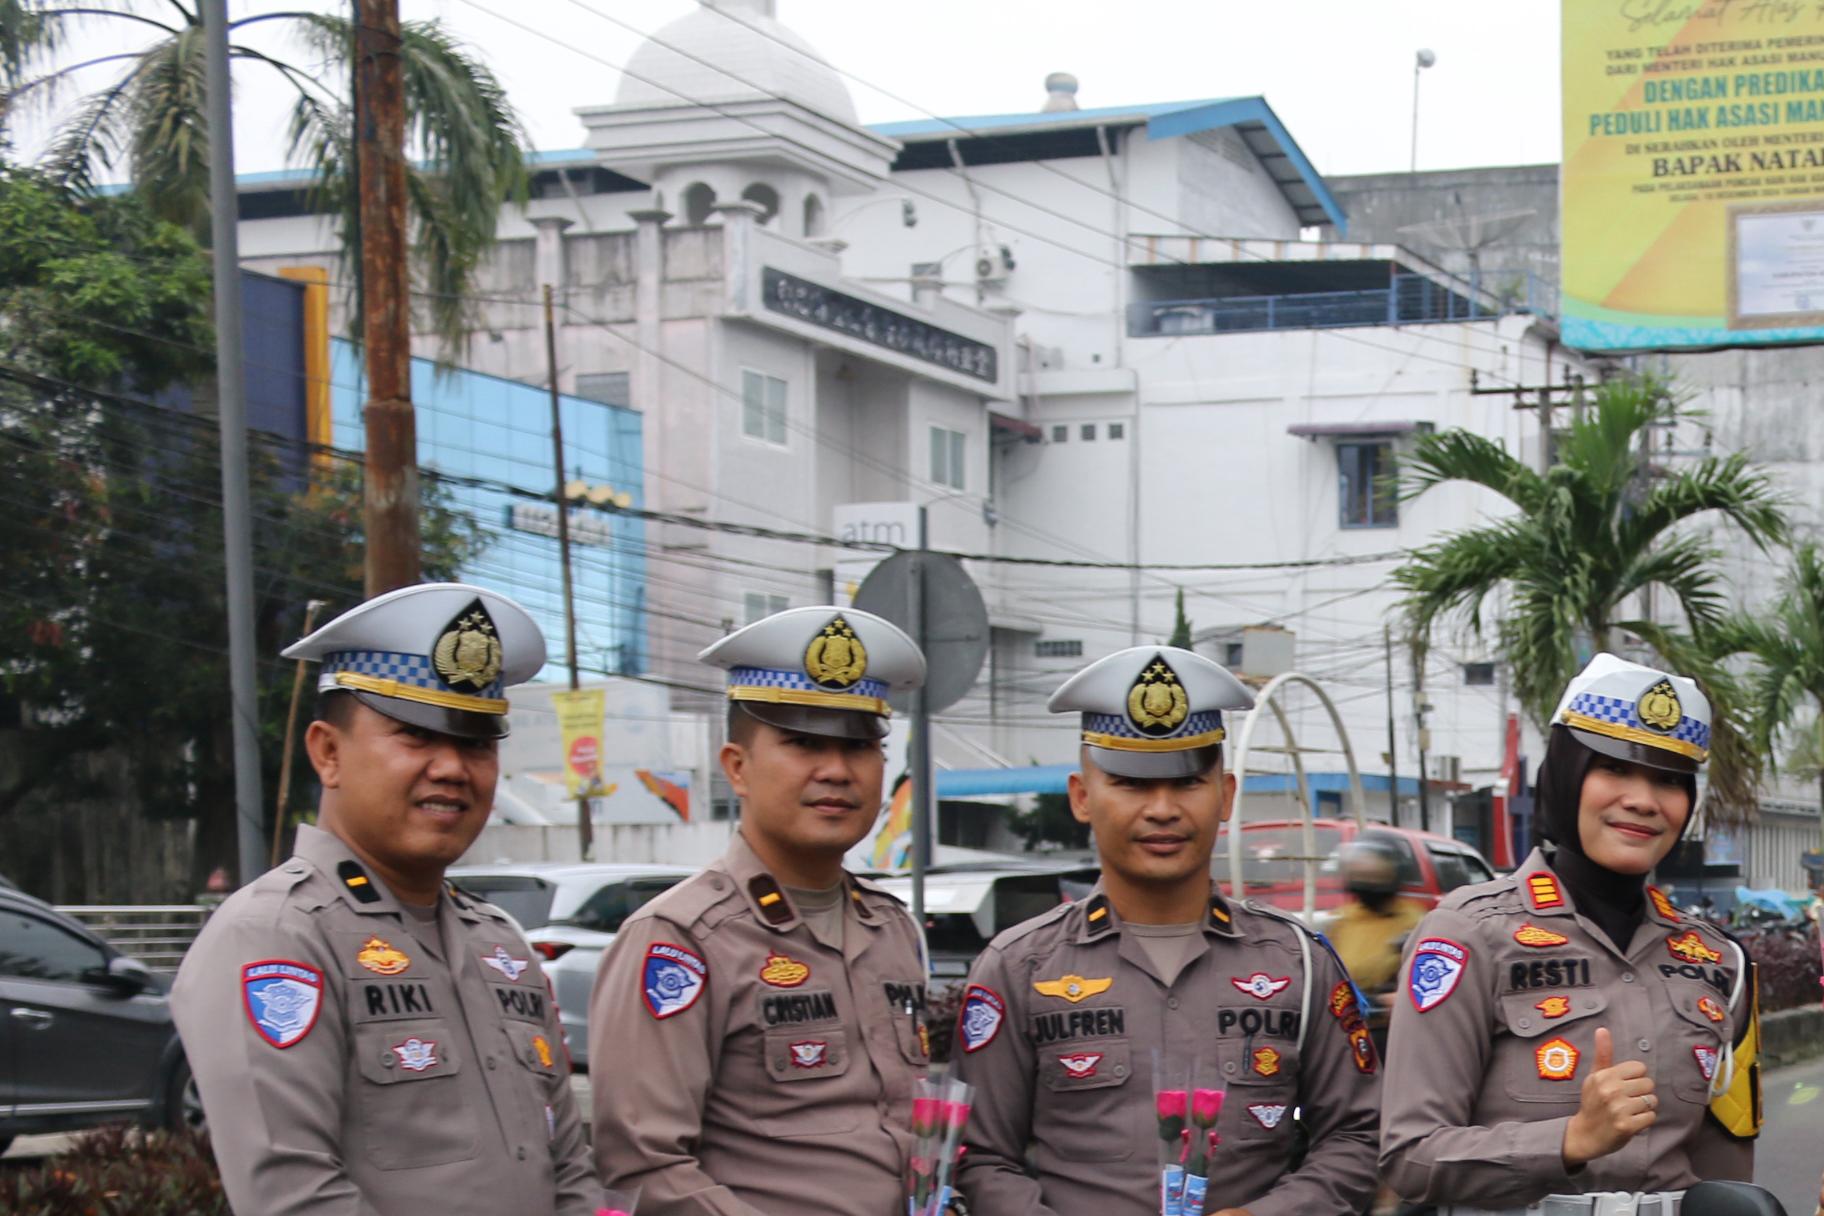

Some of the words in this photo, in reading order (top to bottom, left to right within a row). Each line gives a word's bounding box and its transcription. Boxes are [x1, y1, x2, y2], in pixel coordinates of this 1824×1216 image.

[1606, 49, 1643, 61] YANG
[1648, 44, 1692, 58] TELAH
[1695, 39, 1763, 54] DITERIMA
[1606, 64, 1638, 76] DARI
[1643, 59, 1702, 73] MENTERI
[1707, 56, 1737, 69] HAK
[1742, 52, 1783, 66] ASASI
[1643, 75, 1729, 104] DENGAN
[1589, 110, 1662, 137] PEDULI
[1667, 106, 1711, 132] HAK
[1716, 102, 1780, 129] ASASI
[1625, 143, 1642, 155] DI
[1644, 137, 1719, 154] SERAHKAN
[1722, 135, 1760, 149] OLEH
[1763, 130, 1824, 147] MENTERI
[1652, 151, 1743, 178] BAPAK
[842, 521, 905, 543] atm
[1510, 957, 1591, 991] RESTI
[1658, 963, 1731, 1000] POLR
[364, 983, 433, 1016] RIKI
[496, 988, 545, 1019] POLRI
[763, 992, 839, 1025] CRISTIAN
[1034, 1008, 1126, 1043] JULFREN
